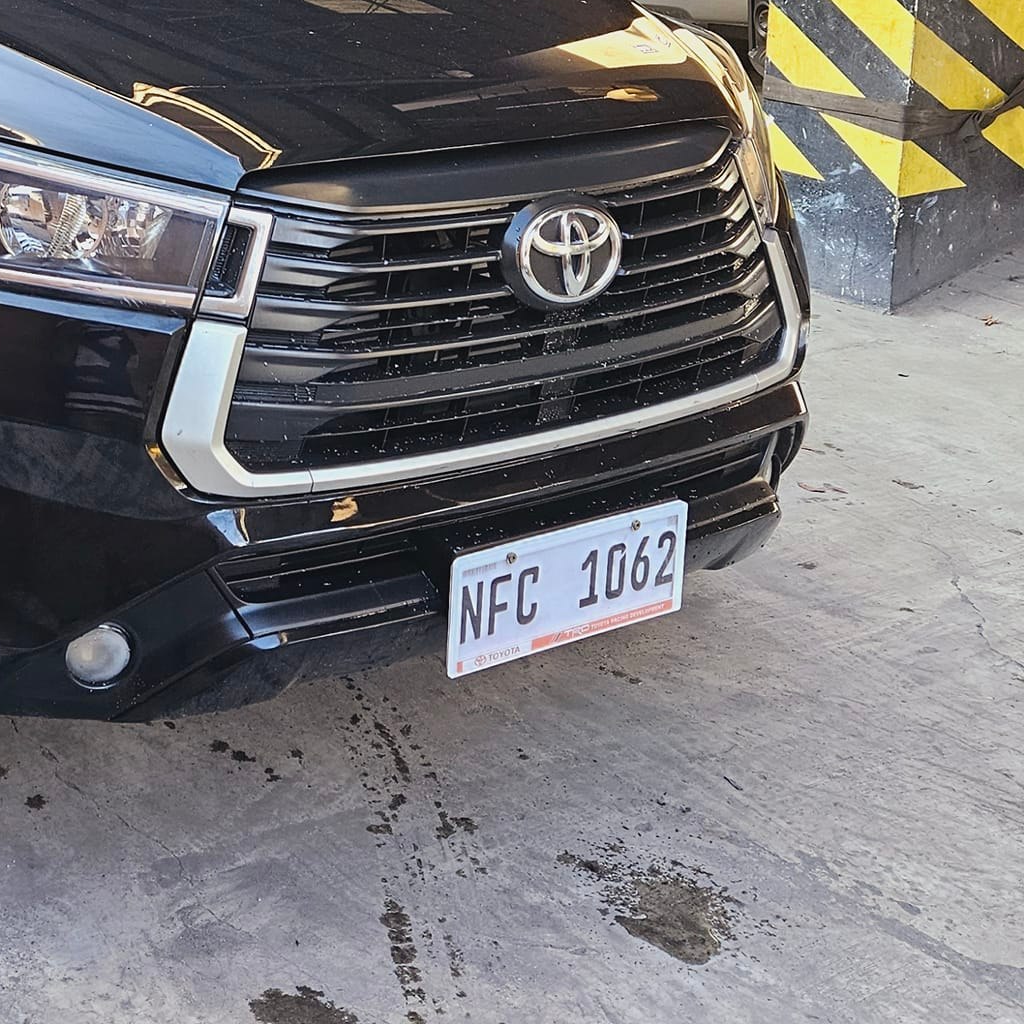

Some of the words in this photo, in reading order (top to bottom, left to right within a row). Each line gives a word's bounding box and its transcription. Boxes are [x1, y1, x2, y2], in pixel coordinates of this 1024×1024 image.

[459, 566, 539, 645] NFC
[579, 530, 677, 608] 1062
[488, 646, 520, 662] TOYOTA
